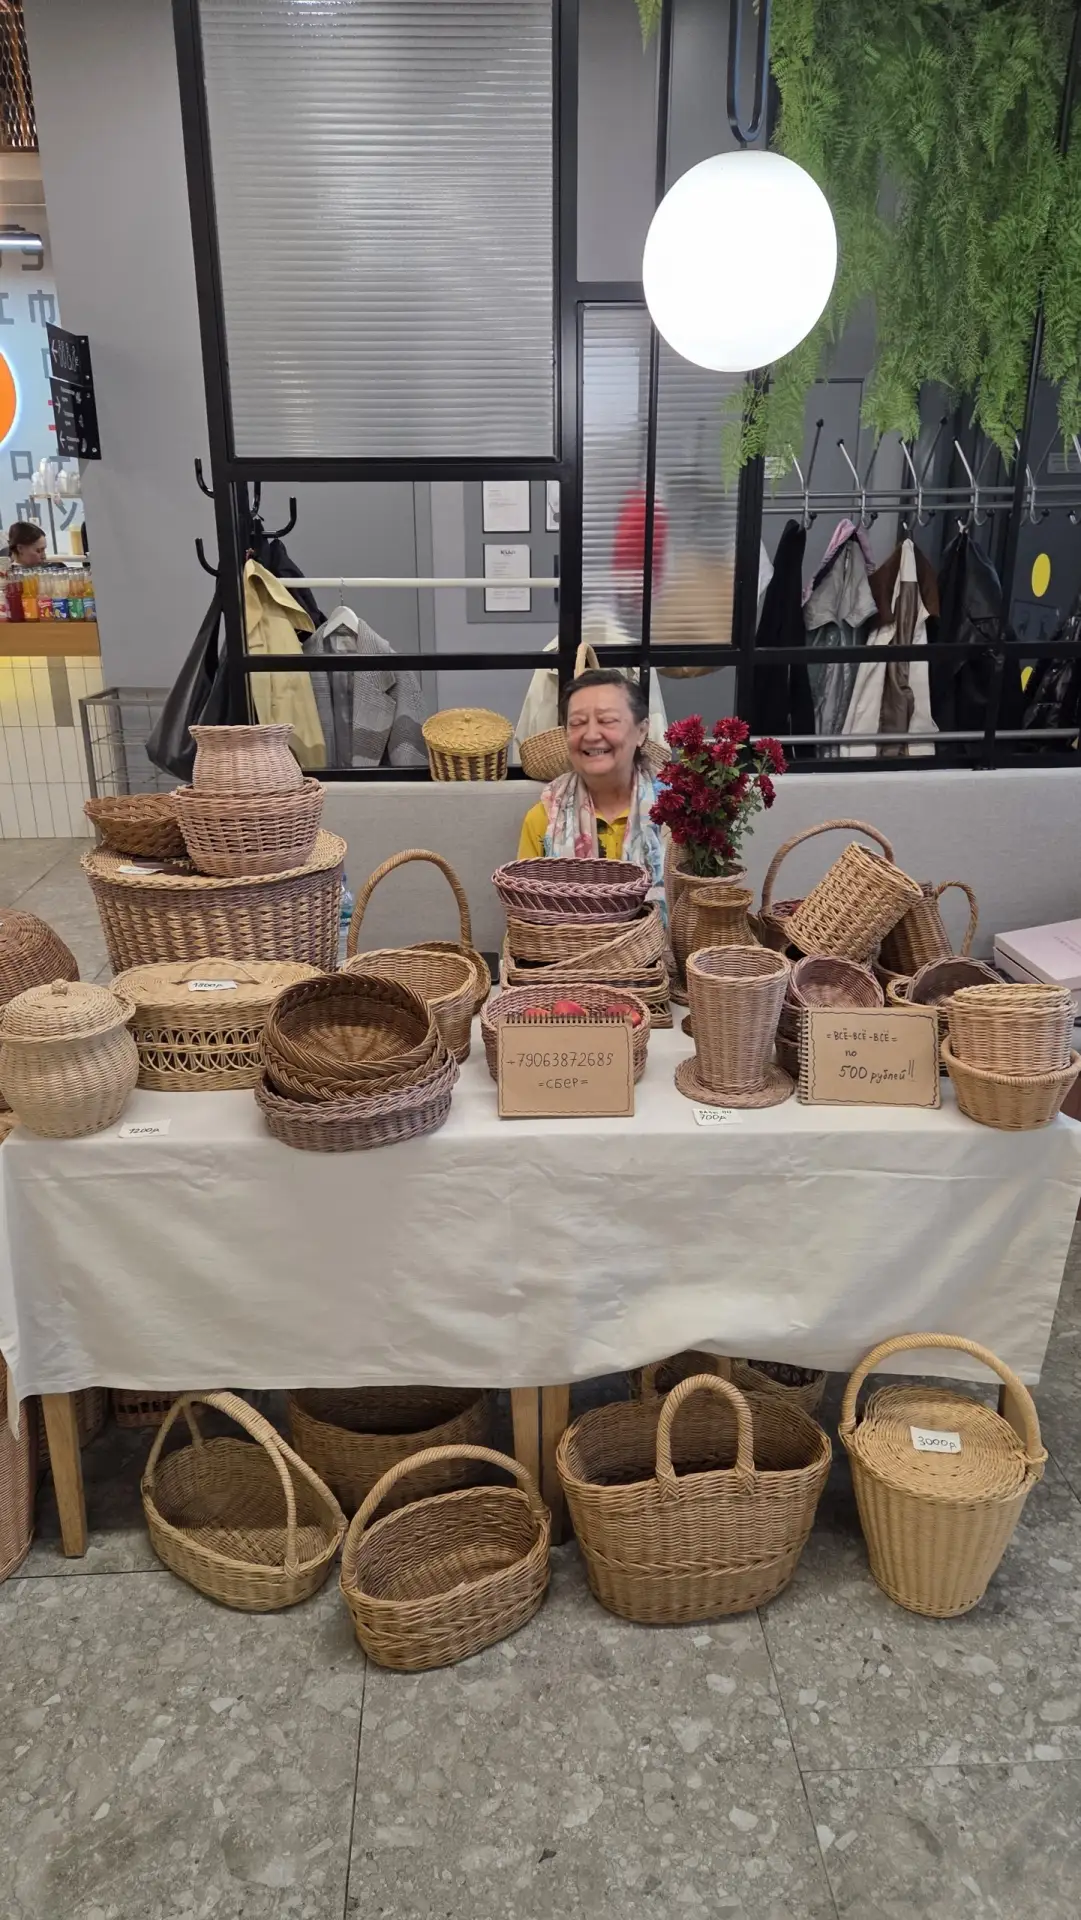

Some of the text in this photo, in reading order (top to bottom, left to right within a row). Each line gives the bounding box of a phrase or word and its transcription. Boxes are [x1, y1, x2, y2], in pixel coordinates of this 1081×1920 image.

[505, 1052, 614, 1067] +79063872685
[845, 1049, 857, 1057] по
[838, 1065, 867, 1079] 500
[918, 1436, 957, 1451] 3000р
